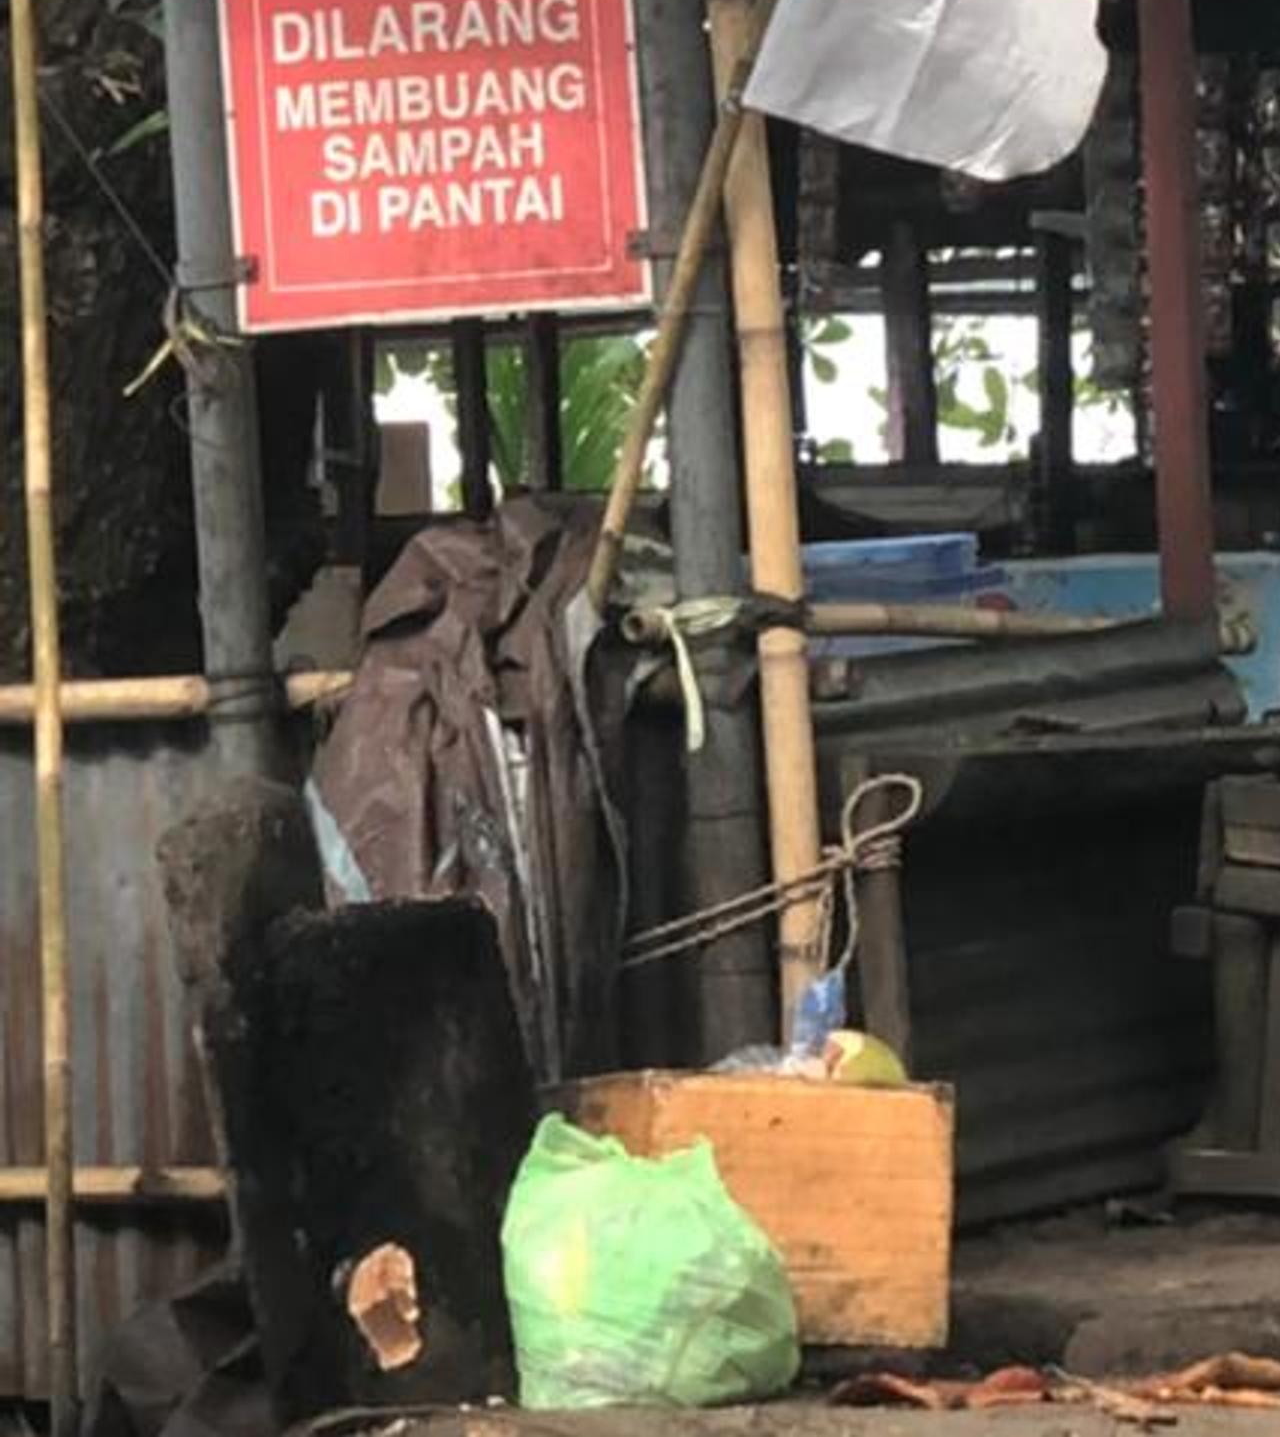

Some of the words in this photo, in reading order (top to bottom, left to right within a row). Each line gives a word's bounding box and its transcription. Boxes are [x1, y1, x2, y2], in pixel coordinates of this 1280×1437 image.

[275, 65, 587, 130] MEMBUANG
[323, 123, 544, 181] SAMPAH
[311, 190, 361, 237] DI
[377, 175, 564, 232] PANTAI
